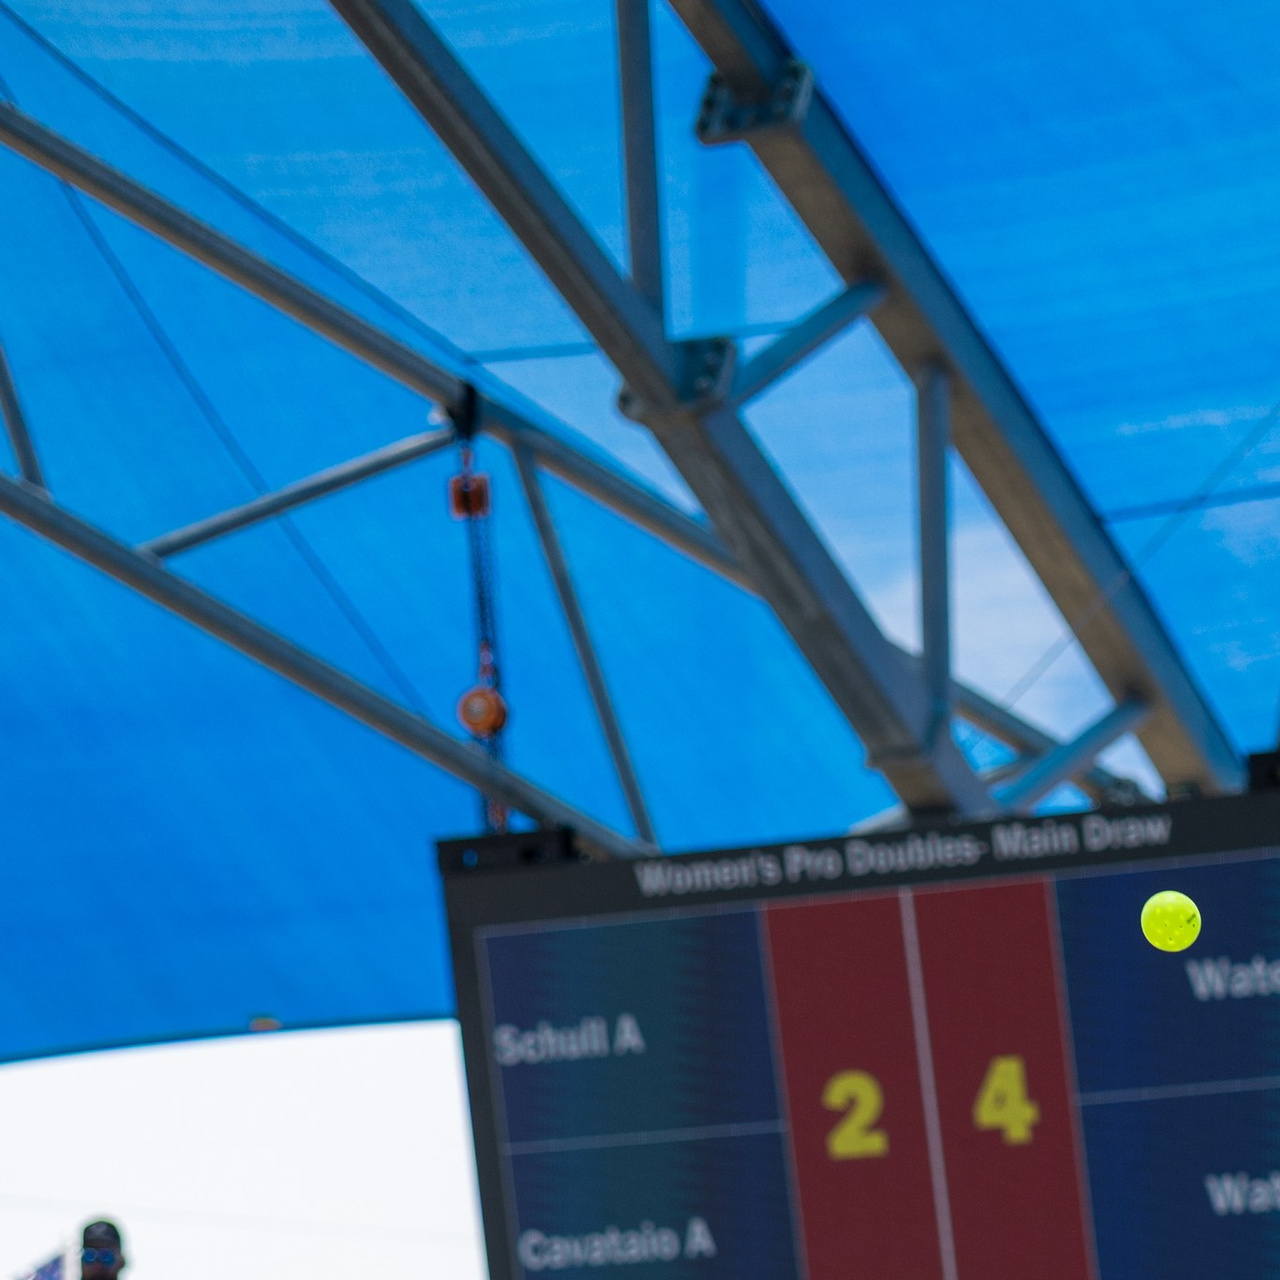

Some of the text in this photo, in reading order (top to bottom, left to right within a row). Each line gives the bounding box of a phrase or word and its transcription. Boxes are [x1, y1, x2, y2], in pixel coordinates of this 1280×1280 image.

[635, 852, 782, 897] Women's
[784, 845, 842, 881] Pro
[993, 822, 1078, 862] Main
[1083, 814, 1172, 852] Draw
[494, 1013, 645, 1066] Schull A
[821, 1069, 889, 1160] 2
[973, 1055, 1039, 1145] 4
[685, 1216, 716, 1258] A
